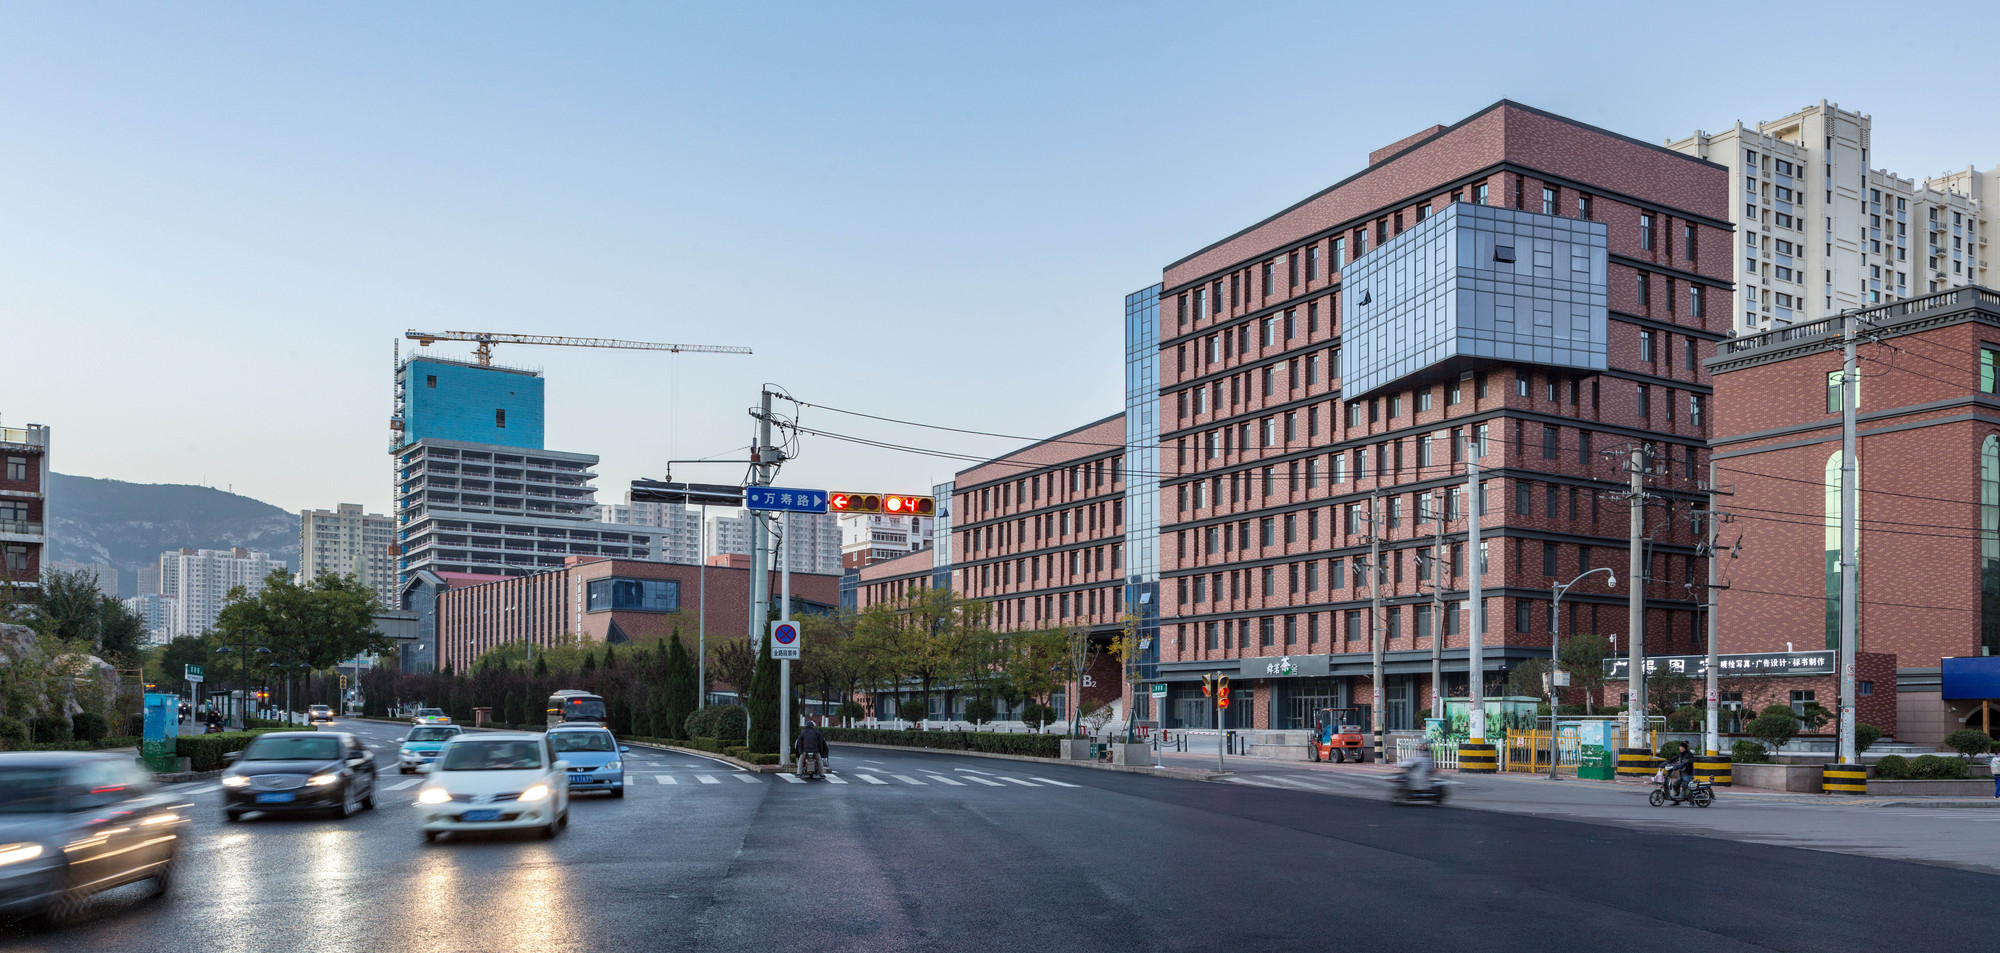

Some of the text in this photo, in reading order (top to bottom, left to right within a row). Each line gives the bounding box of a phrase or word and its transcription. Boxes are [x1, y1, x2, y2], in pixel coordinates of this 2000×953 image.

[764, 492, 810, 507] 万寿路
[903, 499, 917, 512] 4
[1083, 675, 1097, 687] B2
